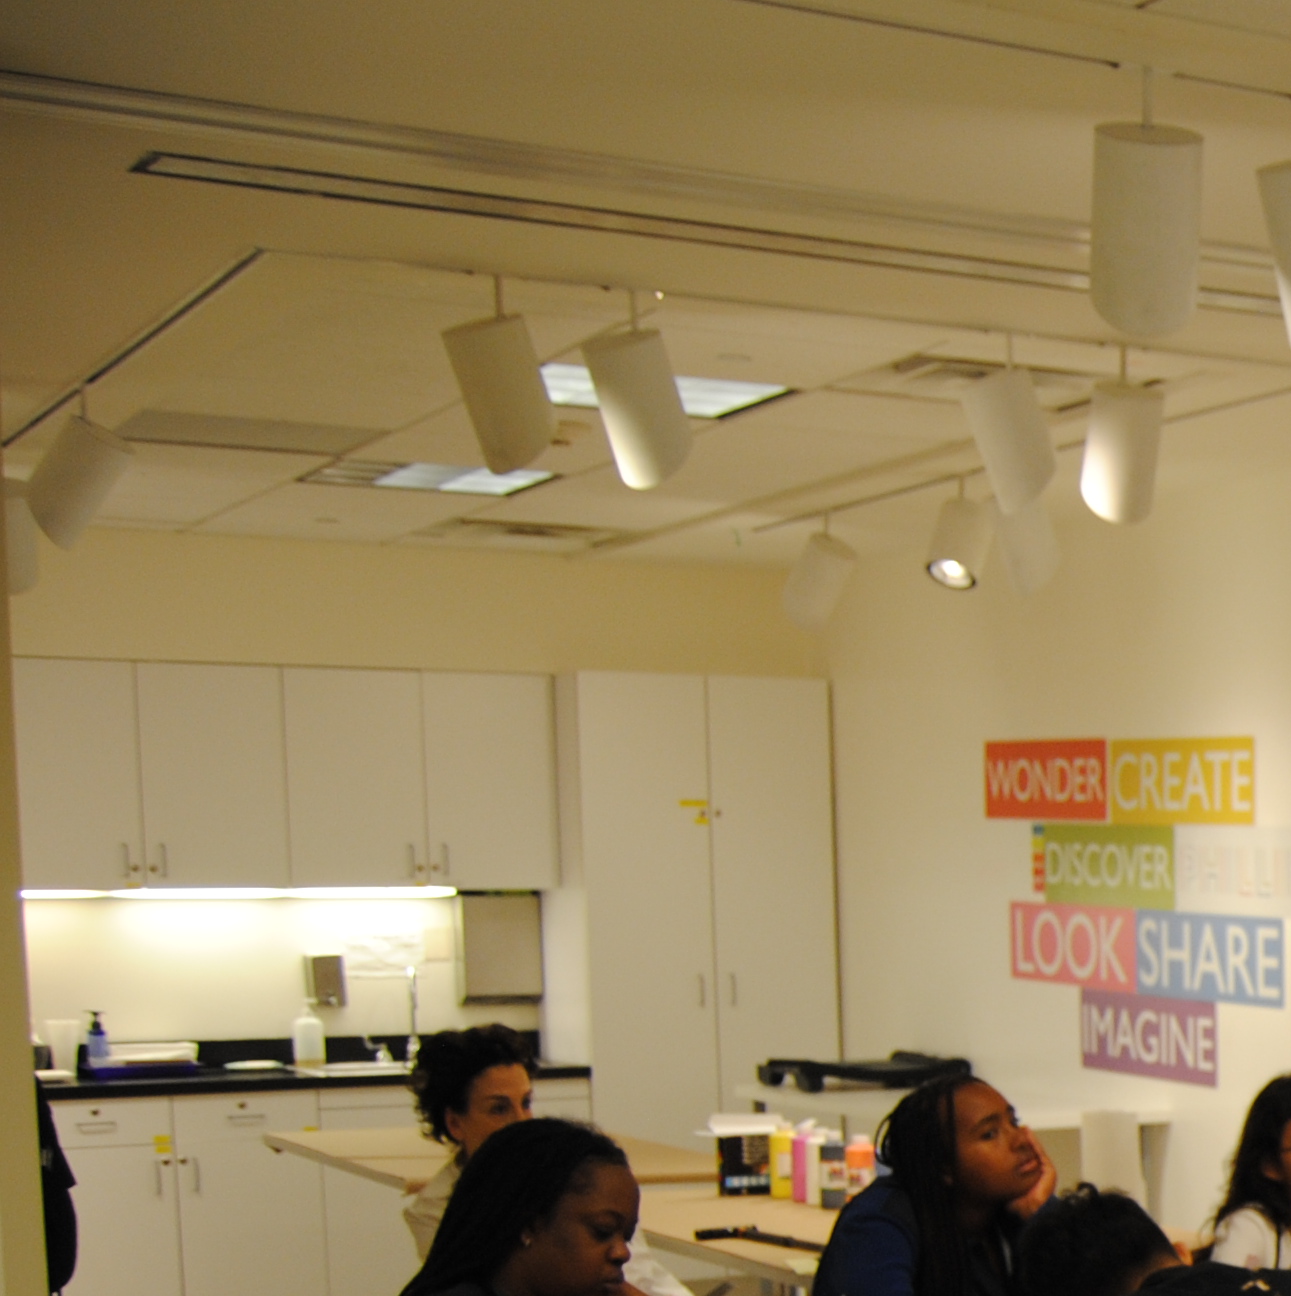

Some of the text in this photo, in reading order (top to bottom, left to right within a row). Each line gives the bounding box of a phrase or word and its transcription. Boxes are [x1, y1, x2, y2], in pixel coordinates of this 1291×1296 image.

[987, 750, 1250, 812] WONDER CREATE
[1045, 842, 1171, 891] DISCOVER
[1014, 909, 1281, 998] LOOK SHARE
[1083, 1003, 1215, 1073] IMAGINE
